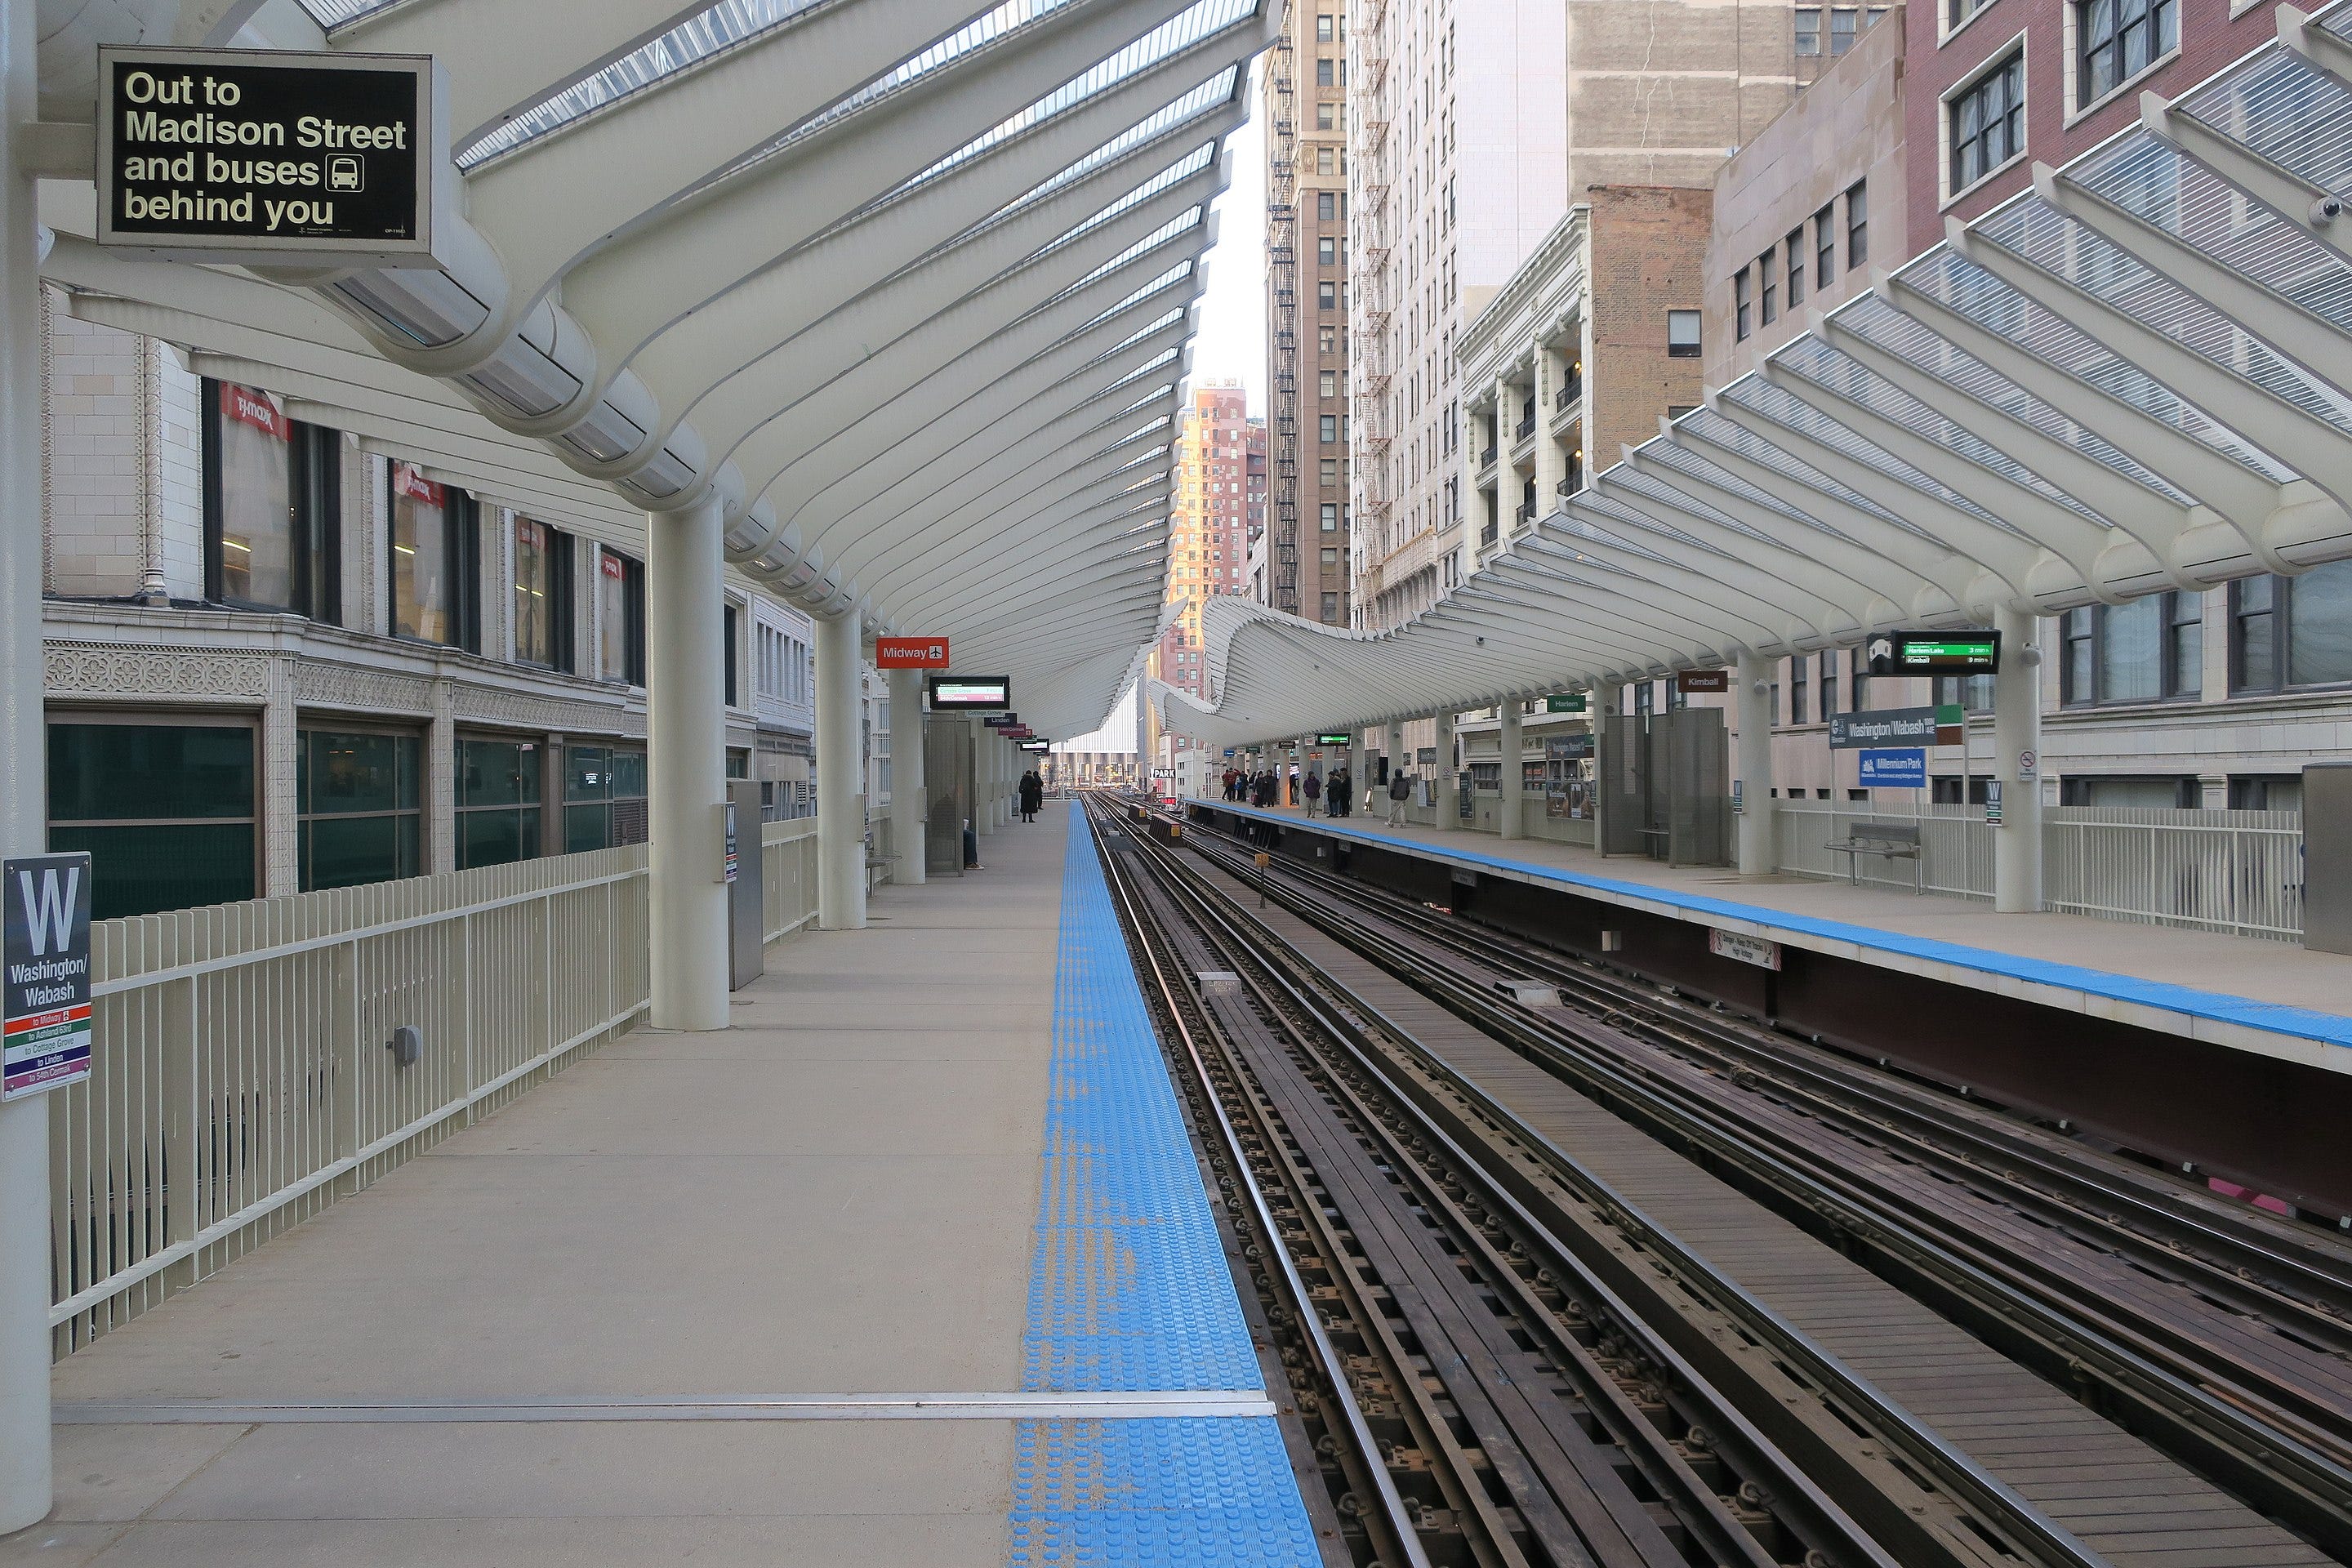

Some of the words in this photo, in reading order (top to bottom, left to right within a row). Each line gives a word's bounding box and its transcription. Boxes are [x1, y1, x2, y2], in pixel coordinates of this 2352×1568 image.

[125, 71, 194, 105] Out
[203, 76, 241, 106] to
[125, 110, 284, 146] Madison
[296, 116, 406, 149] Street
[124, 151, 194, 181] and
[207, 152, 319, 186] buses
[125, 189, 252, 222] behind
[264, 199, 333, 230] you
[884, 648, 928, 660] Midway
[1688, 678, 1718, 686] Kimball
[1849, 720, 1924, 740] Washington/Wabash
[1877, 758, 1907, 768] Millennium
[1908, 758, 1922, 769] Park
[1989, 783, 2000, 800] W
[727, 807, 735, 835] W
[19, 867, 81, 956] W
[11, 952, 87, 984] Washington/
[25, 982, 75, 1008] Wabash
[33, 1018, 38, 1026] to
[40, 1013, 61, 1025] Midway
[25, 1047, 31, 1055] to
[33, 1041, 56, 1054] Cottage
[57, 1037, 74, 1048] Grove
[45, 1054, 64, 1065] Linden
